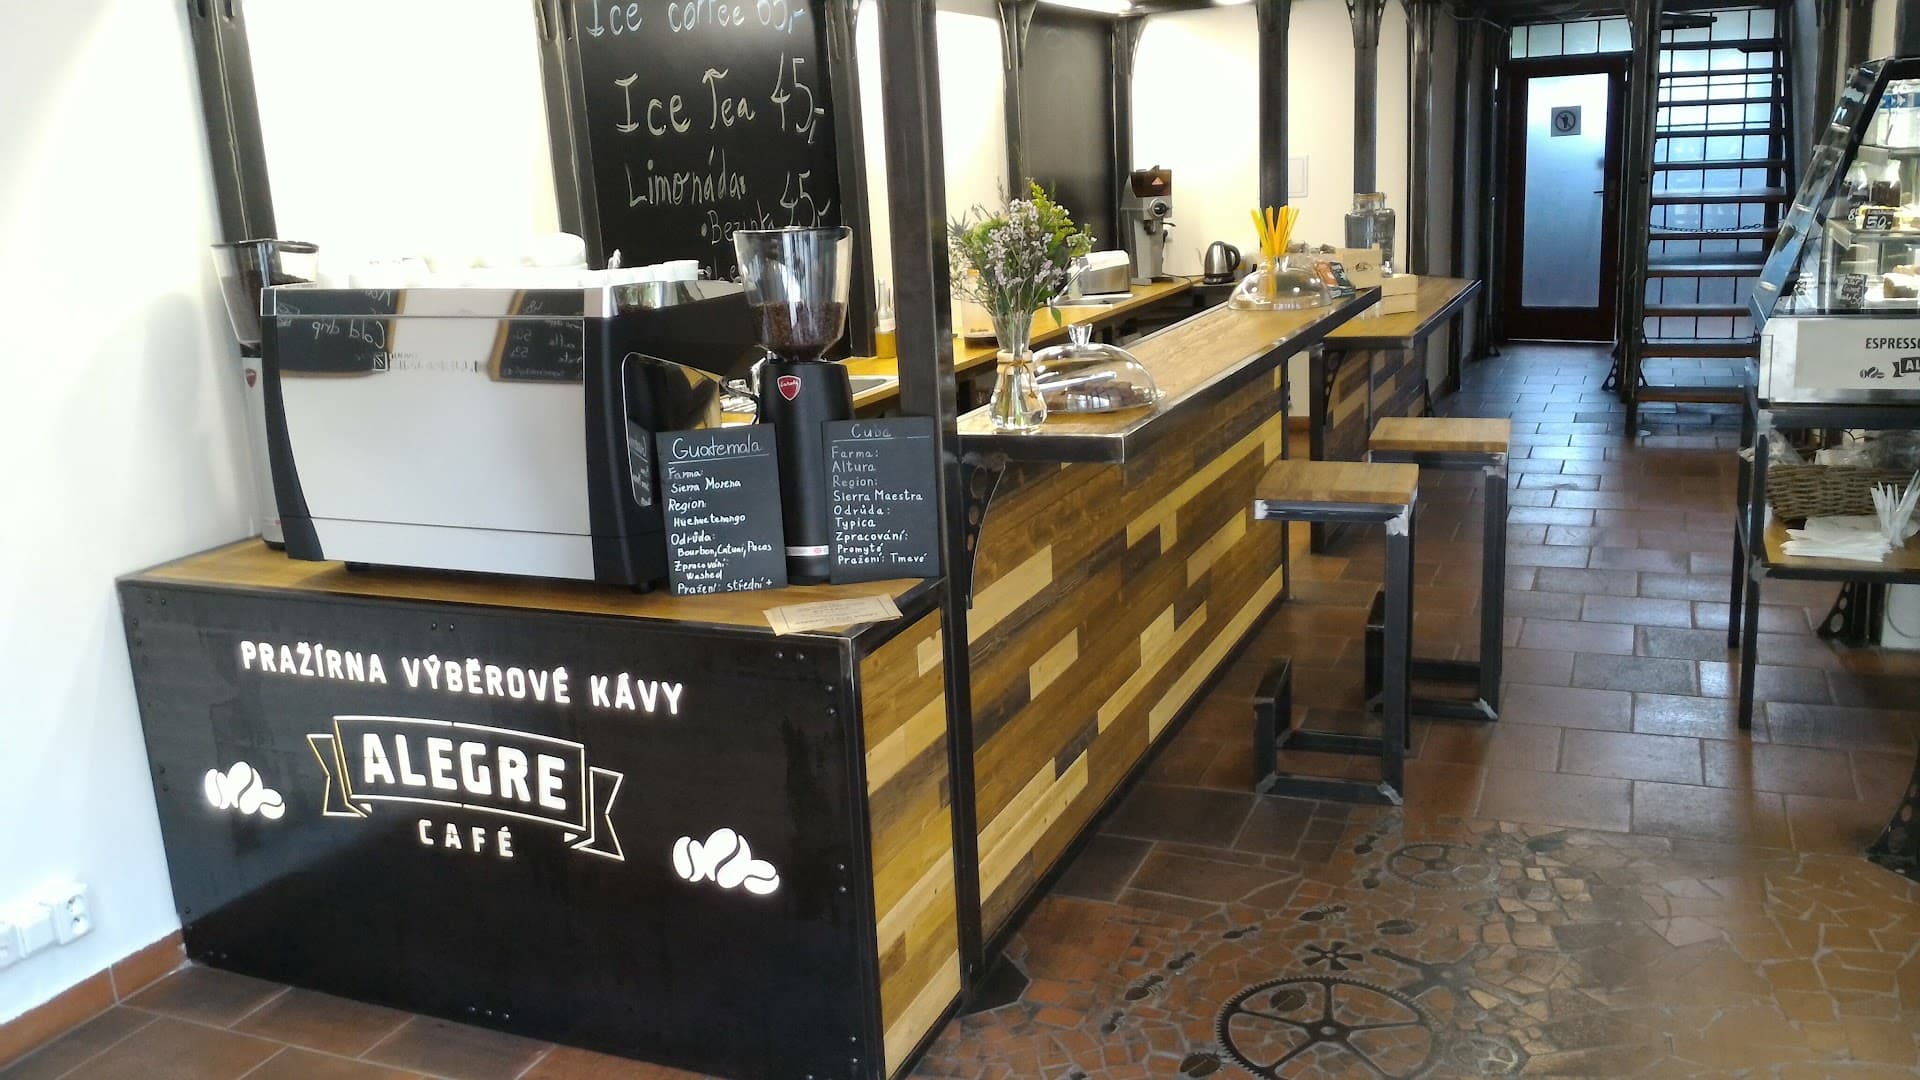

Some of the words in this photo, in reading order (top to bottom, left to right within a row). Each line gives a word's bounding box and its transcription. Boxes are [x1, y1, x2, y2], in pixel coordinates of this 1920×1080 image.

[614, 72, 691, 136] Ice
[702, 67, 756, 131] Tea
[1865, 337, 1920, 350] ESPRESS
[851, 423, 892, 438] Cuba
[672, 433, 761, 459] Guatemala
[831, 446, 879, 459] Farma:
[831, 460, 877, 473] Altura
[670, 482, 701, 494] Sierra
[704, 477, 742, 490] Morena
[832, 475, 879, 489] Region:
[833, 490, 871, 502] Sierra
[874, 489, 924, 501] Maestra
[833, 504, 891, 516] Odrůda:
[835, 517, 877, 530] Typica
[835, 529, 909, 543] Zpracování:
[837, 542, 884, 555] Promyté
[838, 552, 885, 565] Pražení:
[889, 552, 928, 564] Tmavé
[240, 640, 388, 685] PRAŽÍRNA
[401, 654, 571, 705] VÝBĚROVÉ
[589, 672, 684, 715] KÁVY
[362, 732, 567, 812] ALEGRE
[418, 818, 515, 858] CAFÉ
